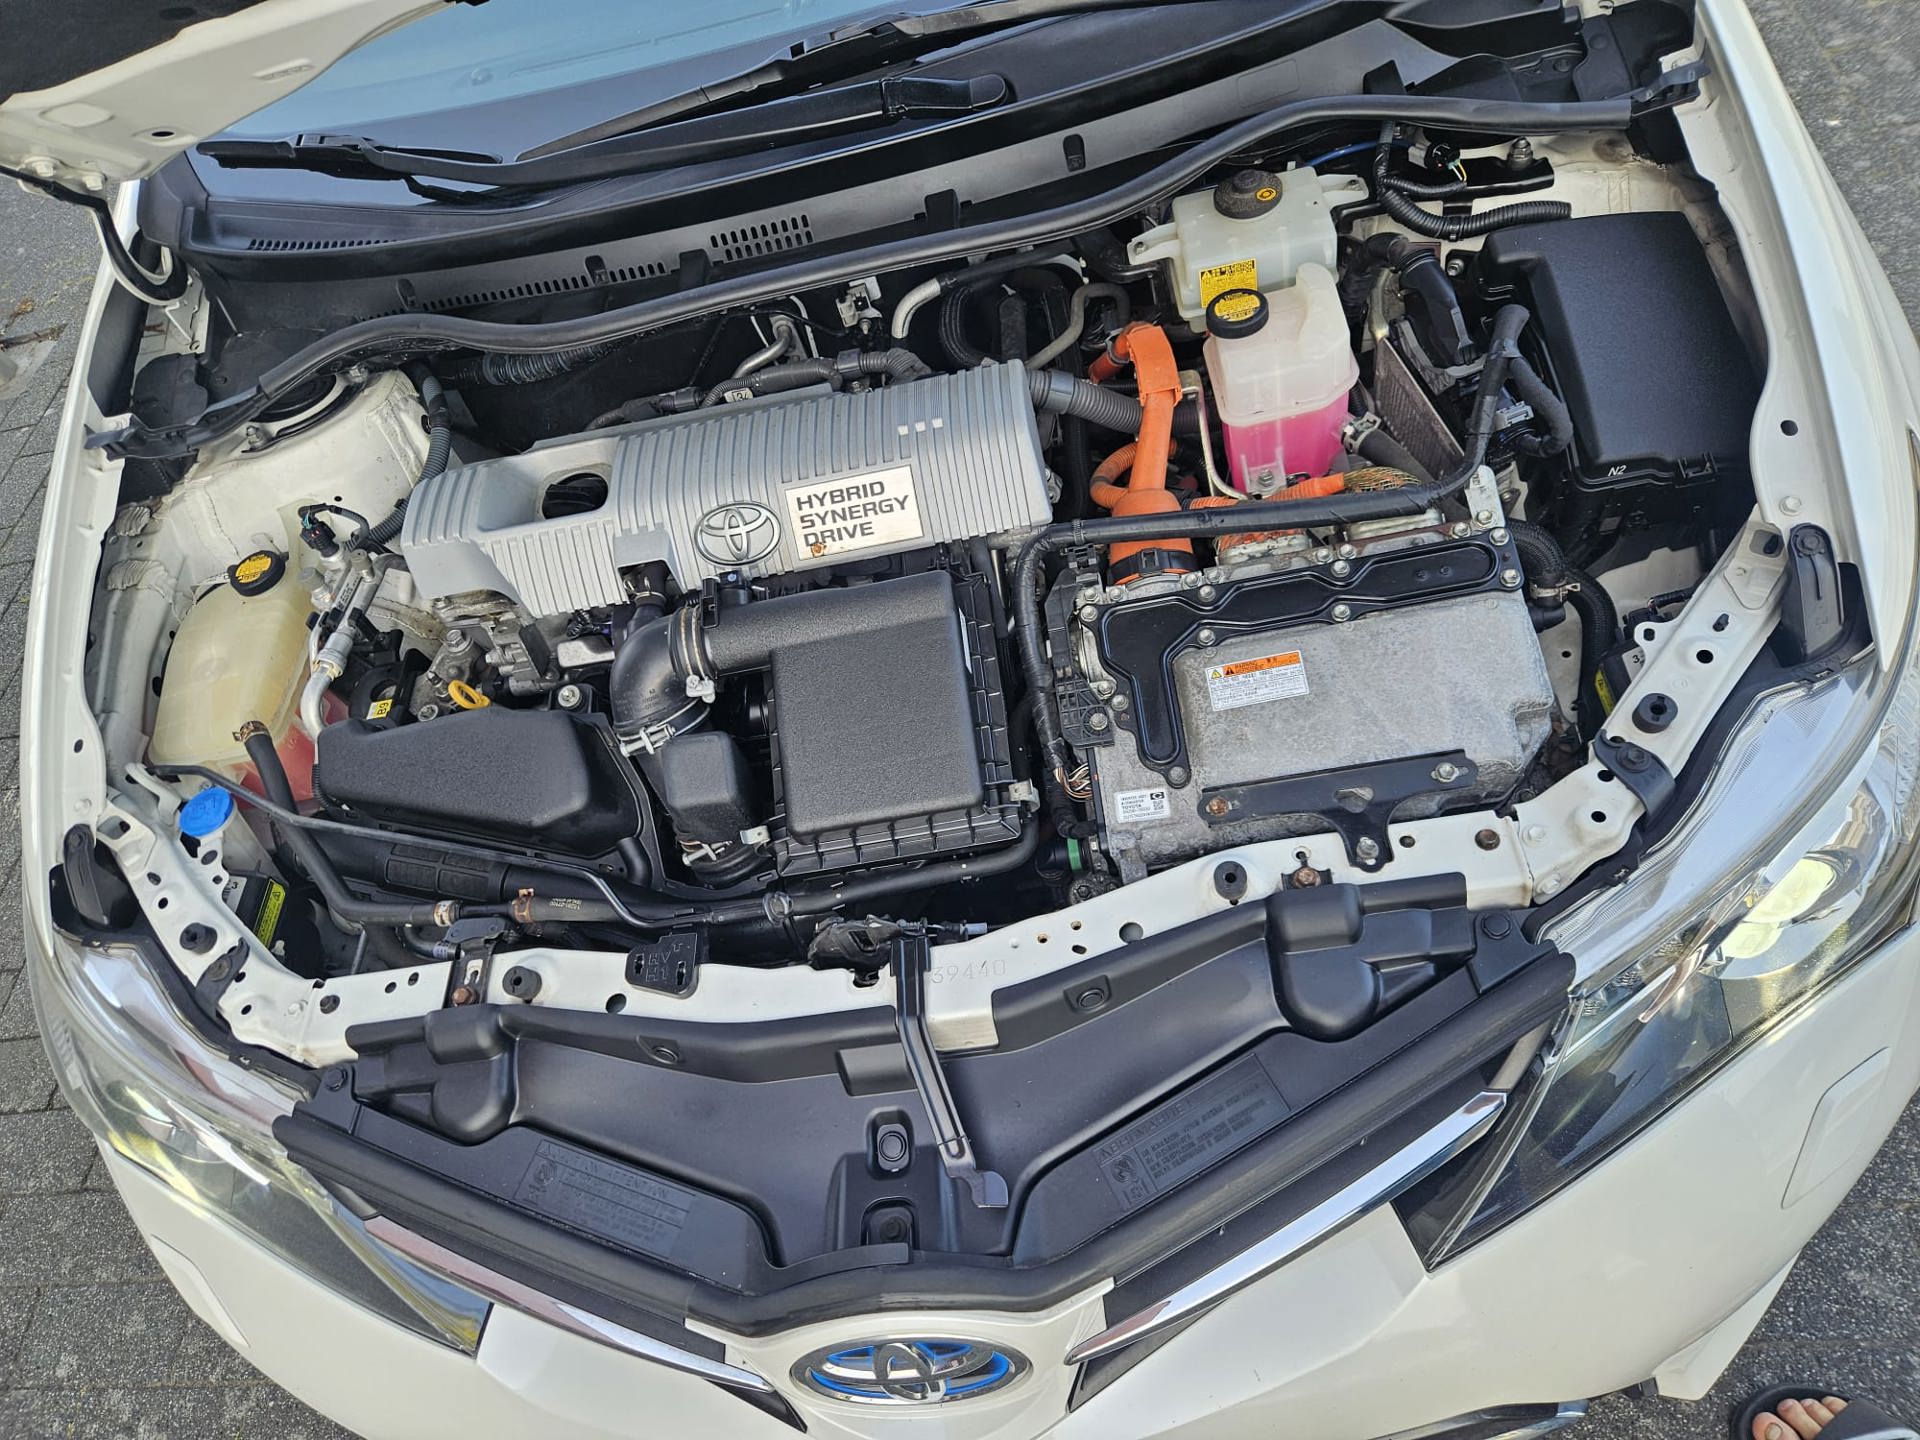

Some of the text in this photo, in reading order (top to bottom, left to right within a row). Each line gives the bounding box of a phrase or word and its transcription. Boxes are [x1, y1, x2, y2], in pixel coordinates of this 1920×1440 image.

[1608, 465, 1626, 477] N2
[796, 481, 885, 511] HYBRID
[800, 495, 909, 529] SYNERGY
[803, 521, 875, 547] DRIVE
[931, 960, 1006, 984] 39440
